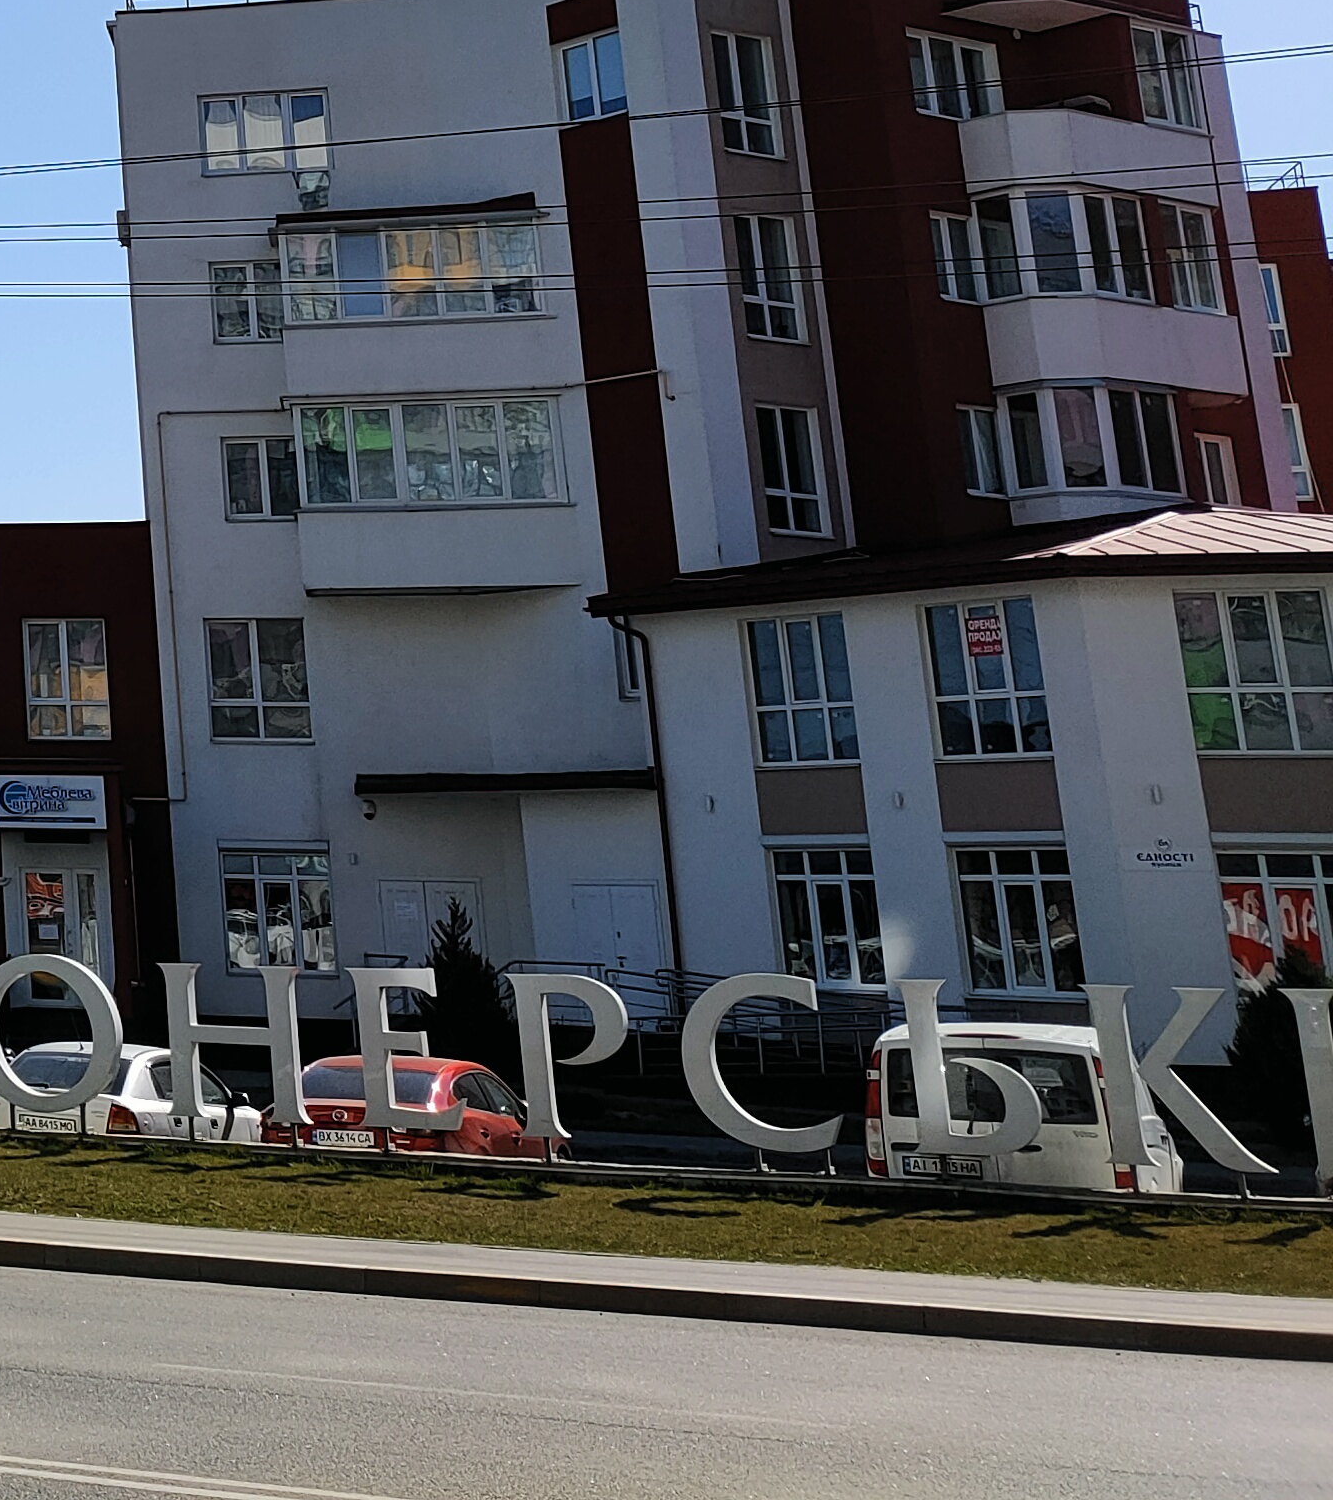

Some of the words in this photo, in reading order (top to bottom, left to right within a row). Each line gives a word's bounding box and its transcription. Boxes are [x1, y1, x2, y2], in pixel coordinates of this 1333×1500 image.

[27, 785, 93, 800] Меблева
[1136, 853, 1194, 862] ЄДНОСТІ
[25, 1117, 37, 1127] AA
[60, 1121, 73, 1131] MO
[357, 1133, 372, 1143] CA
[932, 1161, 958, 1172] 115
